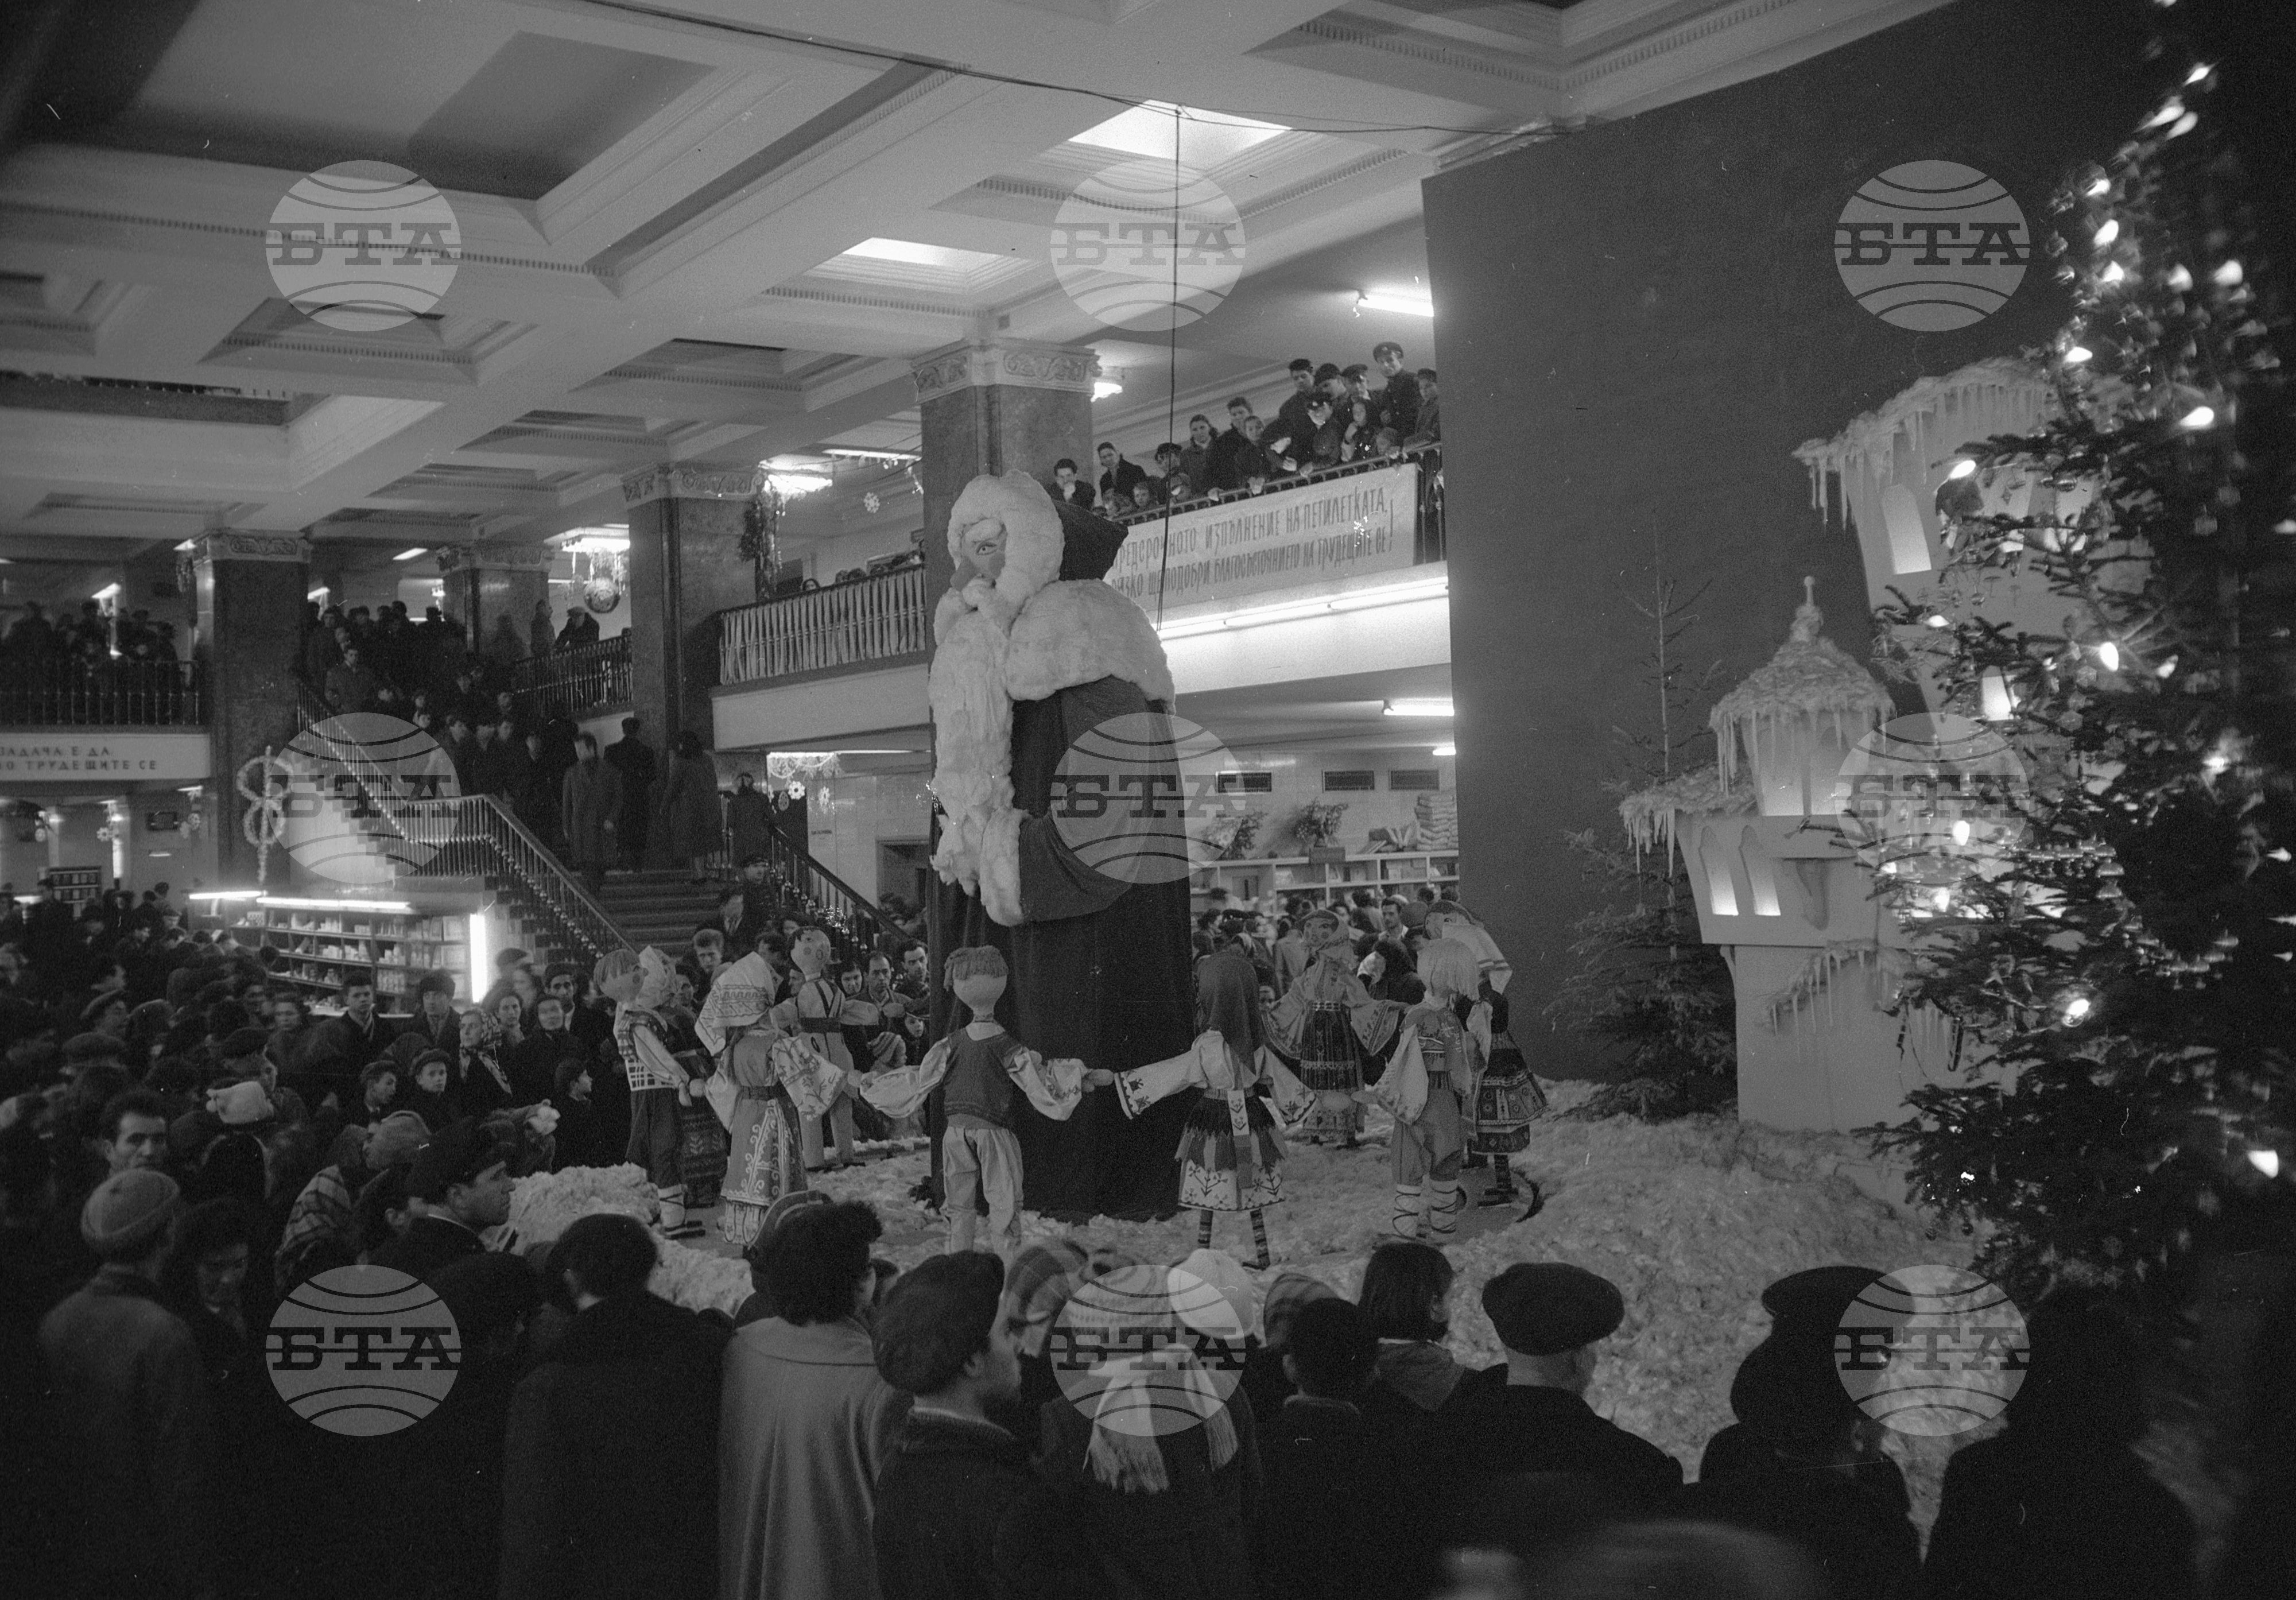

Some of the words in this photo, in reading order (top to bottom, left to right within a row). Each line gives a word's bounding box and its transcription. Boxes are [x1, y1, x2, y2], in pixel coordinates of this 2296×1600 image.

[1205, 510, 1279, 556] ИЗПЪЛНЕНИЕ
[1286, 505, 1300, 533] НА
[1165, 559, 1210, 594] ПОДОБРИ
[1303, 540, 1314, 568] НА
[0, 760, 14, 770] О
[26, 760, 130, 770] ТРУДЕЩИТЕ
[139, 760, 157, 770] СЕ
[72, 746, 79, 756] Е
[88, 746, 110, 757] ДА
